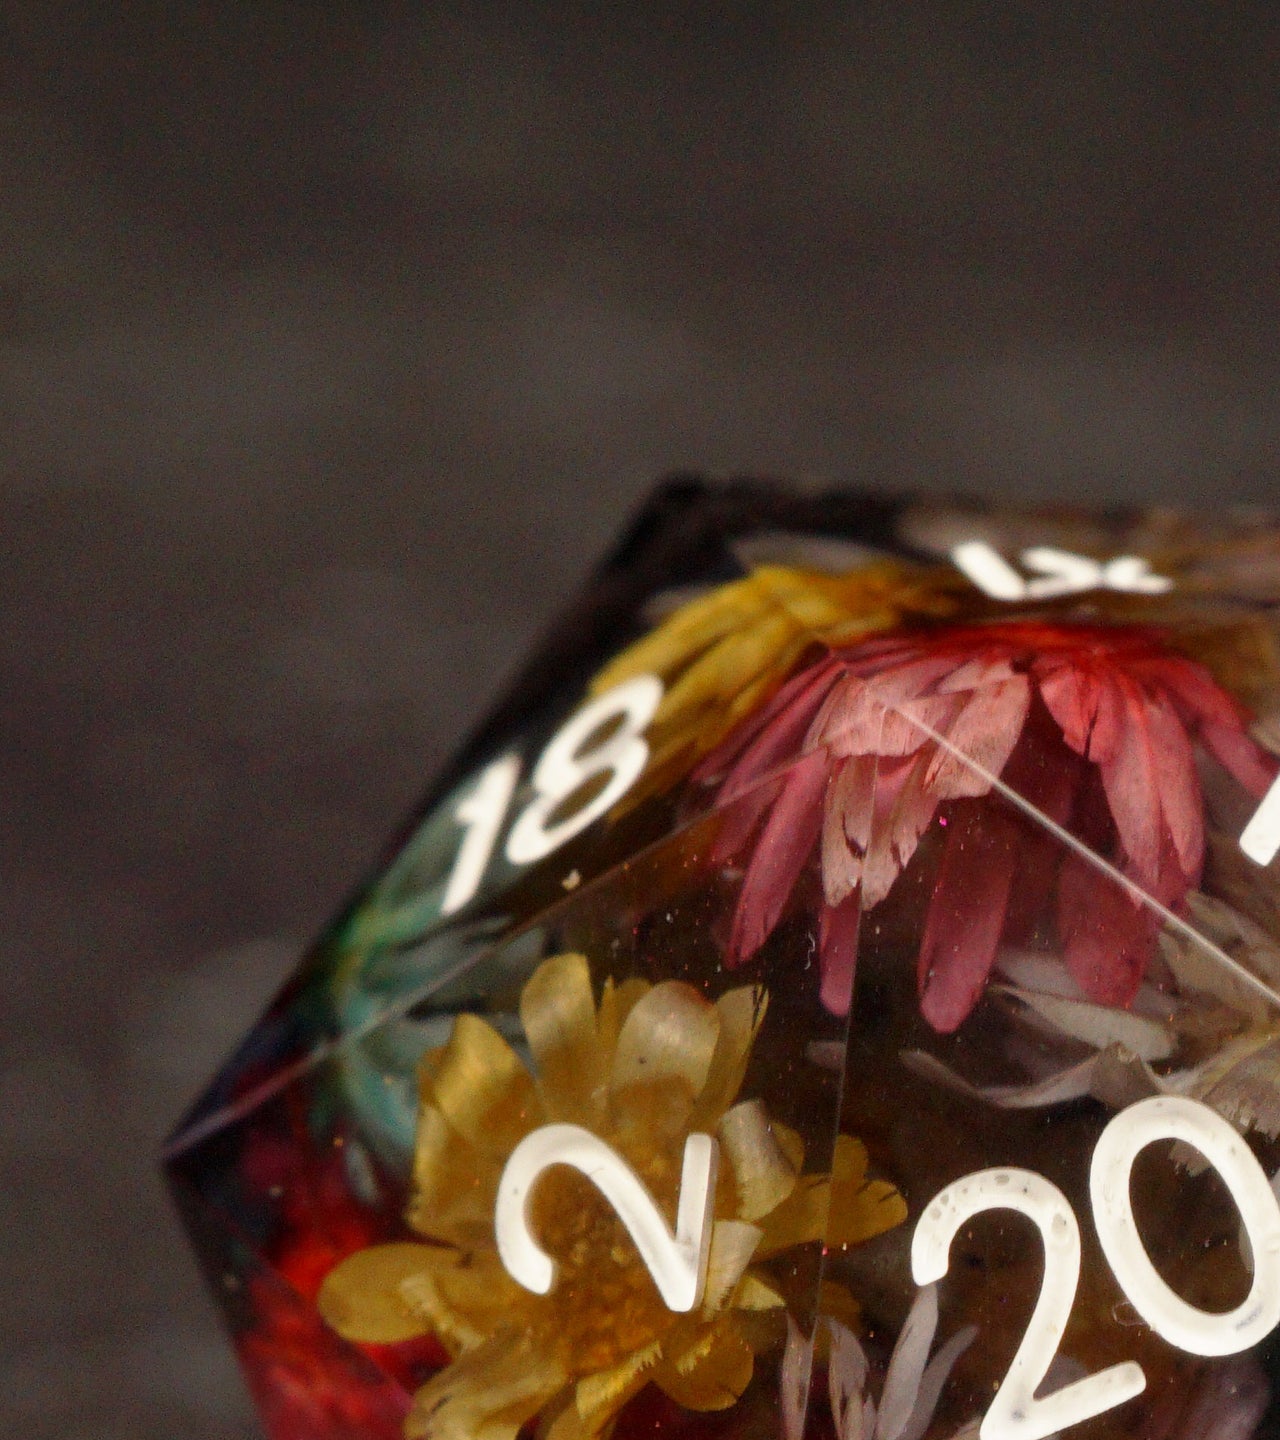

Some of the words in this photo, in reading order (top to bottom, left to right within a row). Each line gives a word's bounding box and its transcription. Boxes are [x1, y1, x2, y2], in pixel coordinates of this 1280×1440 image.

[949, 540, 1171, 600] 4
[443, 673, 665, 914] 18
[494, 1123, 718, 1312] 2
